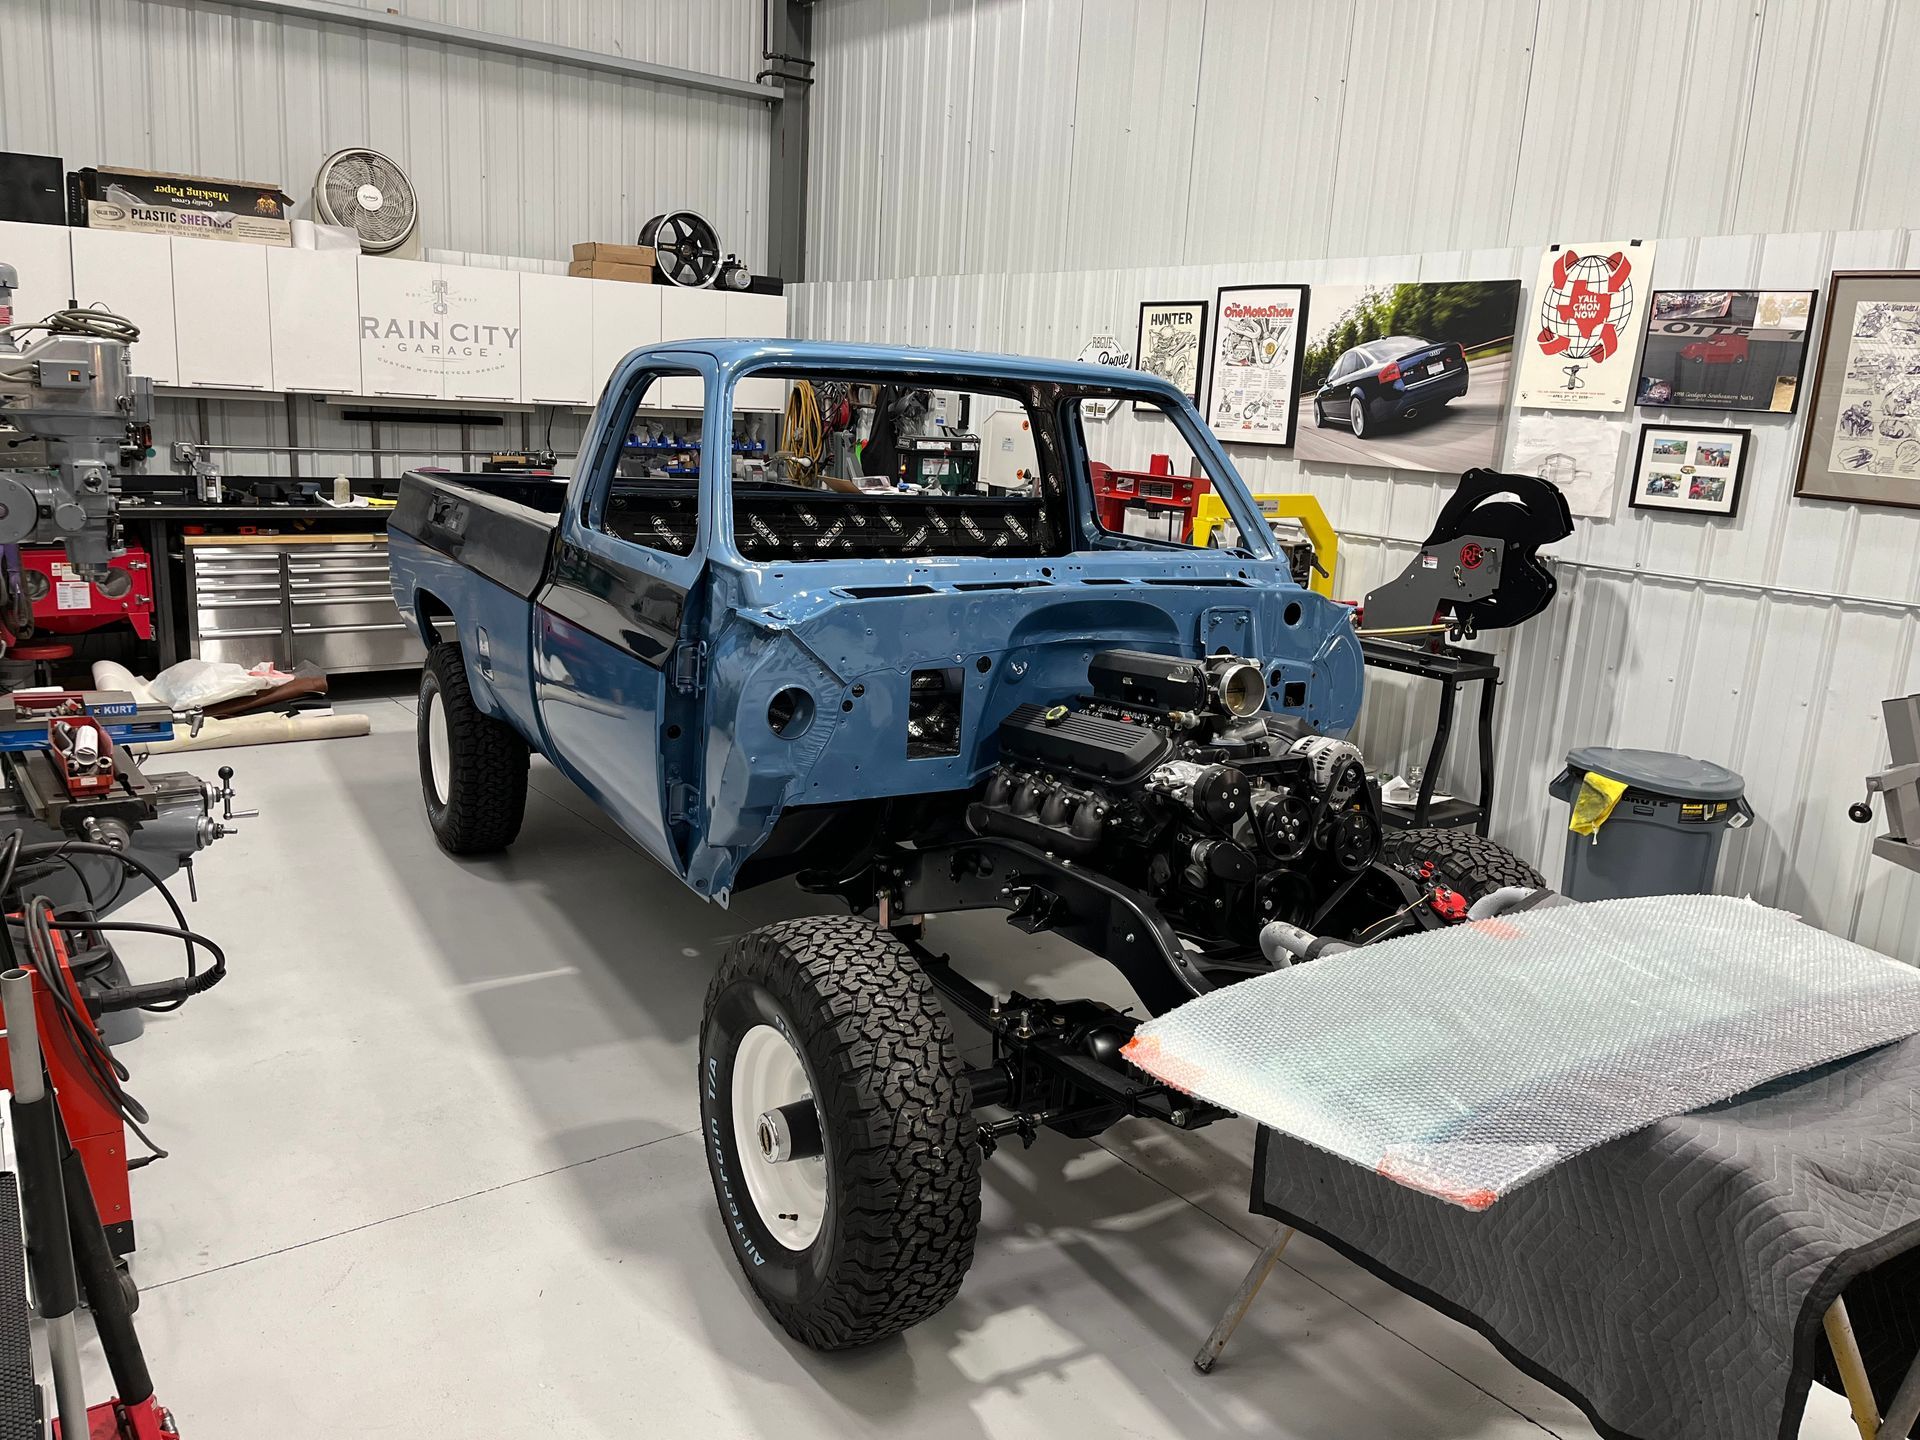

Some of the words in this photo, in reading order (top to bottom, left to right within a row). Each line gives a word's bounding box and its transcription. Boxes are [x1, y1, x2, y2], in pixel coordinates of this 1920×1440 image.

[153, 184, 184, 197] Paper
[186, 187, 230, 202] Masking
[171, 197, 191, 206] Green
[191, 198, 214, 207] Quality
[131, 208, 177, 223] PLASTIC
[180, 213, 232, 229] SHEETG
[131, 220, 167, 229] OVERSPRAY
[168, 223, 204, 233] PROTECTIVE
[205, 227, 234, 236] SHEETING
[1577, 295, 1598, 303] Y'ALL
[1572, 303, 1601, 311] C'MON
[1150, 312, 1193, 326] HUNTER
[1574, 311, 1597, 319] NOW
[361, 316, 439, 340] RAIN
[449, 323, 519, 349] CITY
[397, 343, 488, 357] GARAGE
[377, 357, 412, 370] CUSTOM
[416, 367, 471, 375] MOTORCYCLE
[475, 364, 505, 374] DESIGN
[103, 705, 134, 714] KURT
[708, 1057, 718, 1100] T/A
[711, 1117, 766, 1267] All-Terrain
